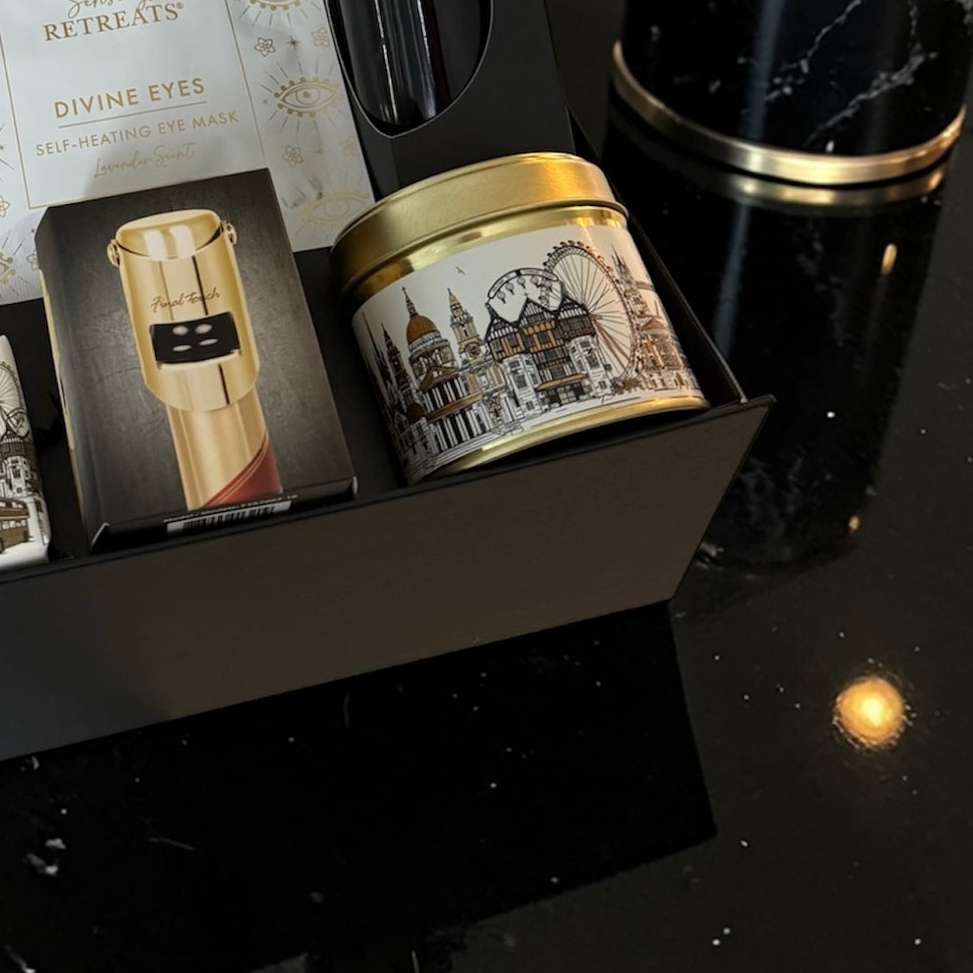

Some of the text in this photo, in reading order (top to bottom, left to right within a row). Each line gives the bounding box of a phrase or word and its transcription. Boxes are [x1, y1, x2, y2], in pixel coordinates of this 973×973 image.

[54, 77, 206, 119] DIVINE EYES
[36, 110, 240, 156] SELF-HEATING EYE MASK
